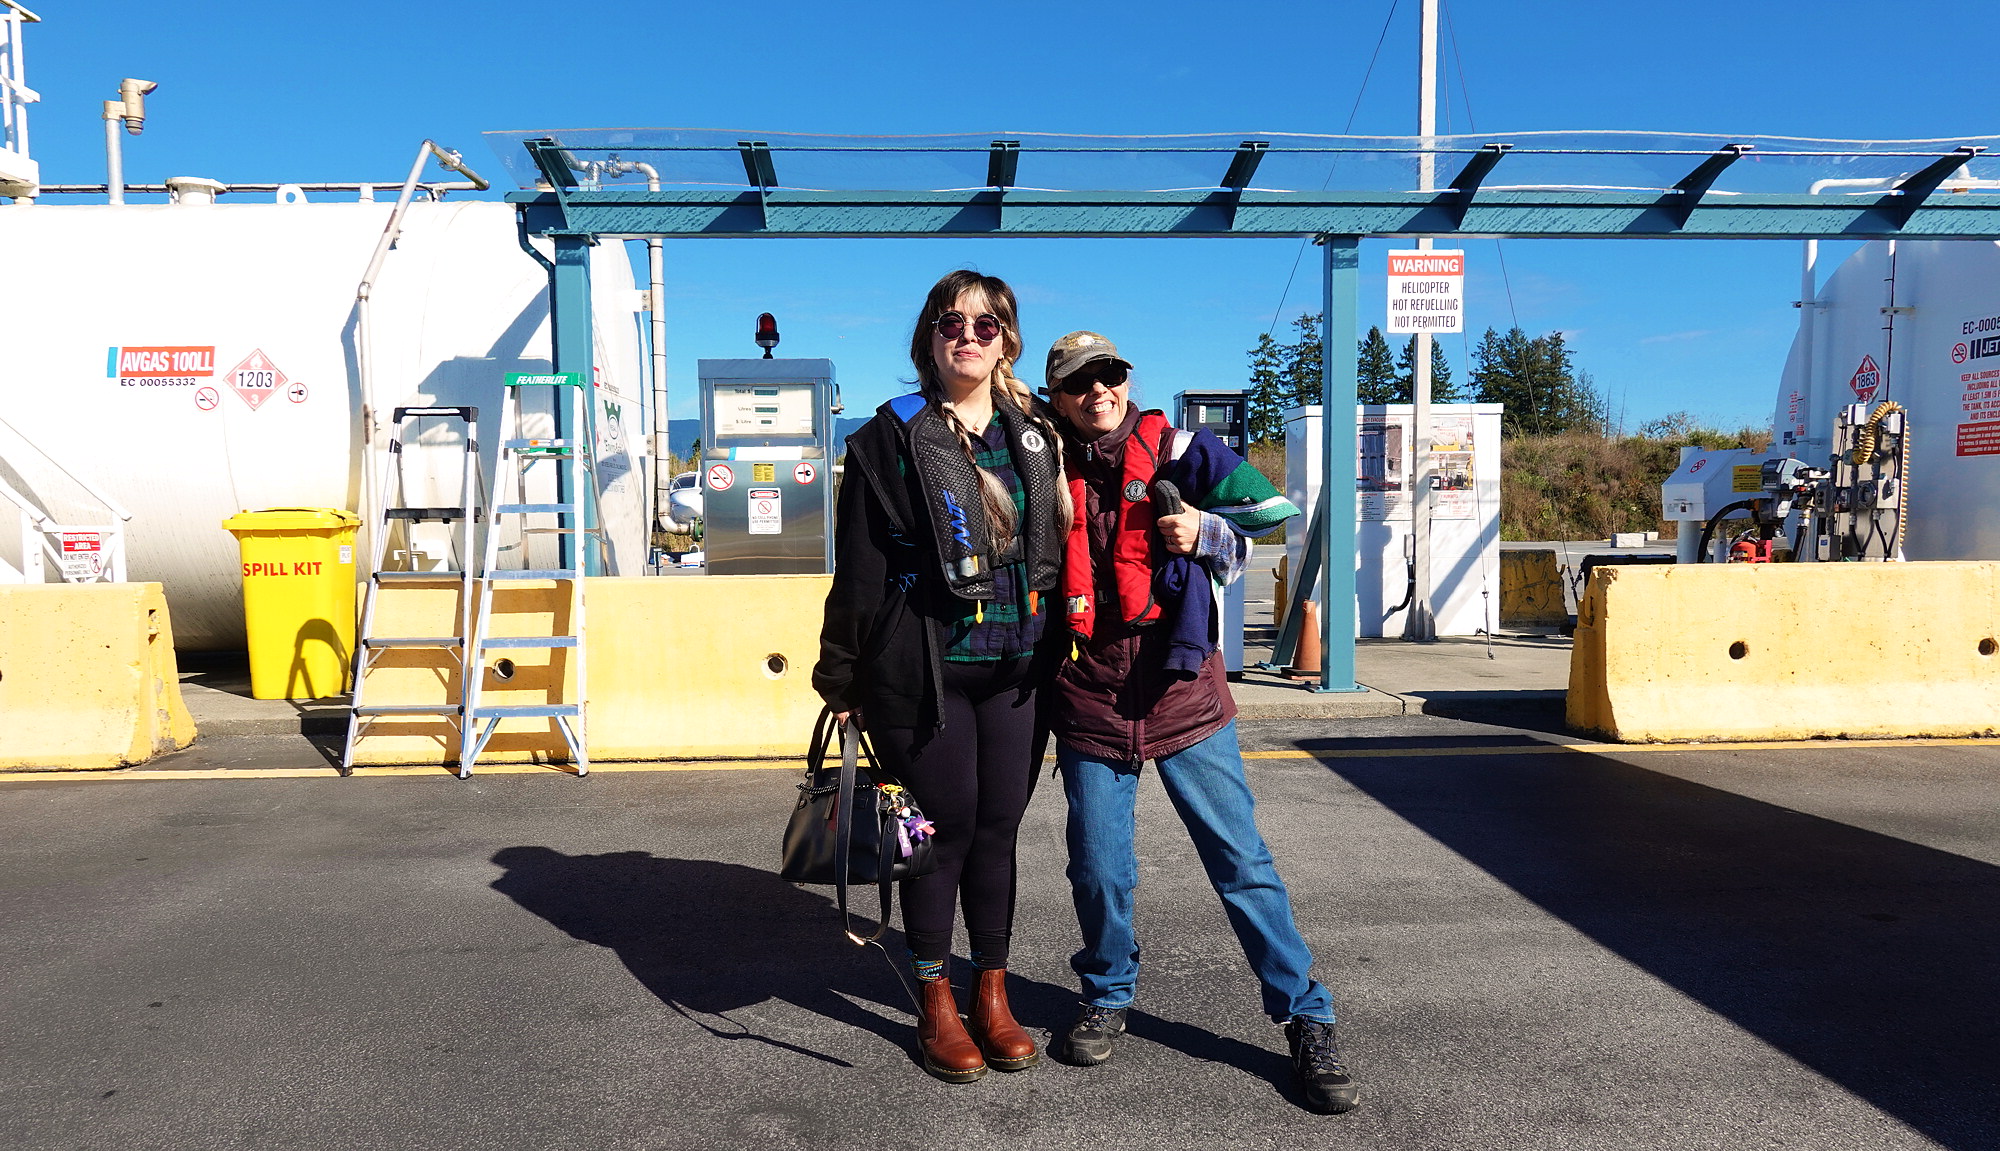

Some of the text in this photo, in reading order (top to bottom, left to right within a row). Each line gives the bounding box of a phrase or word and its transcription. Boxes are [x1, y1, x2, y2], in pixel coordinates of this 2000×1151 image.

[1392, 259, 1459, 272] WARNING
[1401, 282, 1450, 294] HELICOPTER
[1392, 298, 1458, 311] HOT REFUELLING
[1394, 315, 1456, 328] NOT PERMITTED
[122, 351, 214, 372] AVGAS 100LL
[238, 371, 273, 388] 1203
[516, 375, 568, 384] FEATHERLITE
[1857, 372, 1876, 388] 1863
[1980, 370, 1999, 379] SOURCES
[120, 377, 196, 387] EC 00055332
[1967, 380, 1998, 391] INCLUDING ALL
[250, 394, 260, 405] 3
[1863, 391, 1869, 400] 3
[1968, 392, 1980, 400] LEAST
[1970, 412, 1979, 420] AND
[1979, 411, 1987, 419] ITS
[64, 533, 99, 542] RESTRICTED
[74, 542, 92, 550] AREA
[243, 562, 322, 577] SPILL KIT
